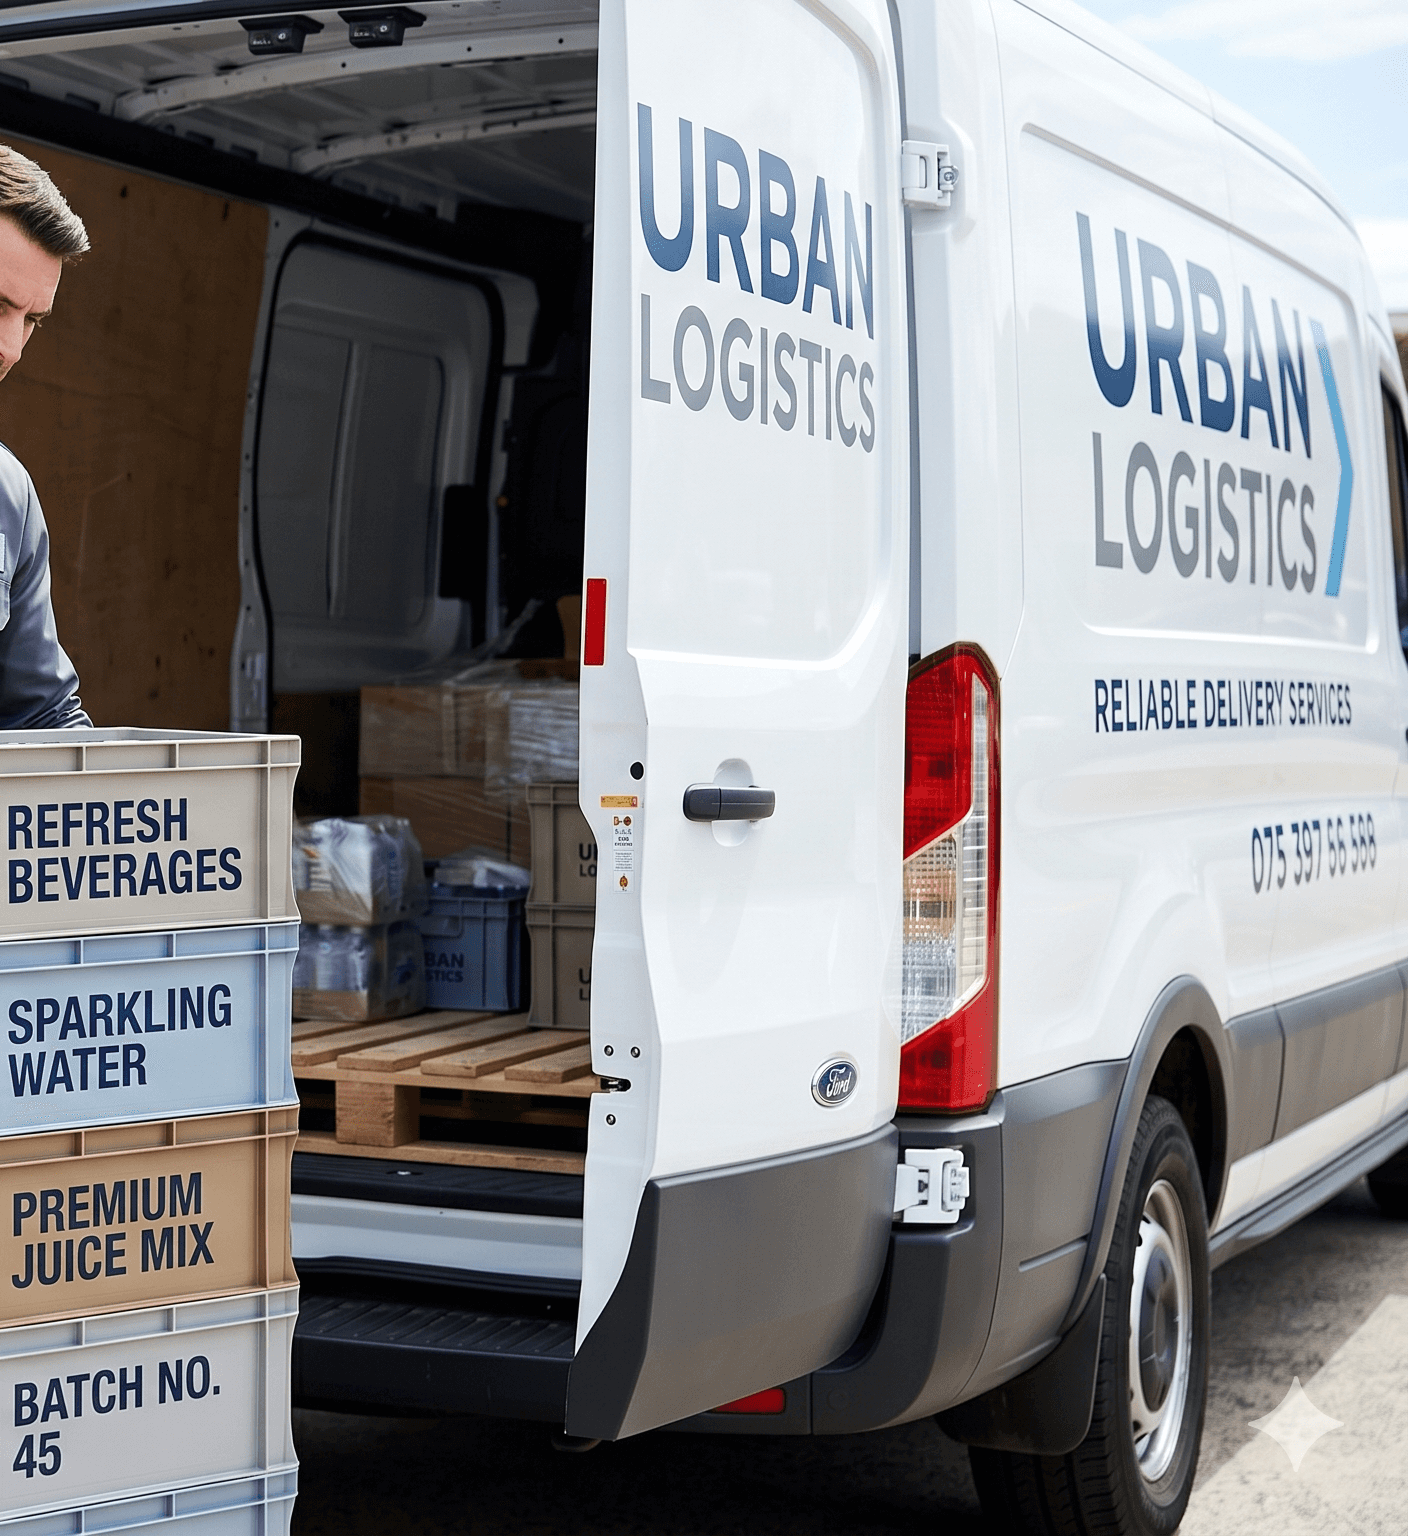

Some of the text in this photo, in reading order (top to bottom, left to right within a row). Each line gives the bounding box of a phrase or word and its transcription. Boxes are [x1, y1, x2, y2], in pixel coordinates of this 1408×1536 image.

[636, 102, 874, 340] URBAN
[1075, 210, 1312, 459] URBAN
[640, 293, 875, 454] LOGISTICS
[1091, 432, 1318, 595] LOGISTICS
[1095, 679, 1352, 733] RELIABLE DELIVERY SERVICES
[8, 797, 188, 851] REFRESH
[1251, 827, 1287, 895] 075
[1290, 820, 1322, 887] 397
[1327, 817, 1347, 879] 66
[8, 846, 242, 904] BEVERAGES
[424, 951, 465, 969] BAN
[8, 983, 232, 1045] SPARKLING
[8, 1043, 147, 1098] WATER
[826, 1066, 852, 1098] Ford
[13, 1171, 202, 1237] PREMIUM
[11, 1221, 215, 1289] JUICE MIX
[14, 1355, 221, 1427] BATCH NO.
[12, 1430, 62, 1479] 45
